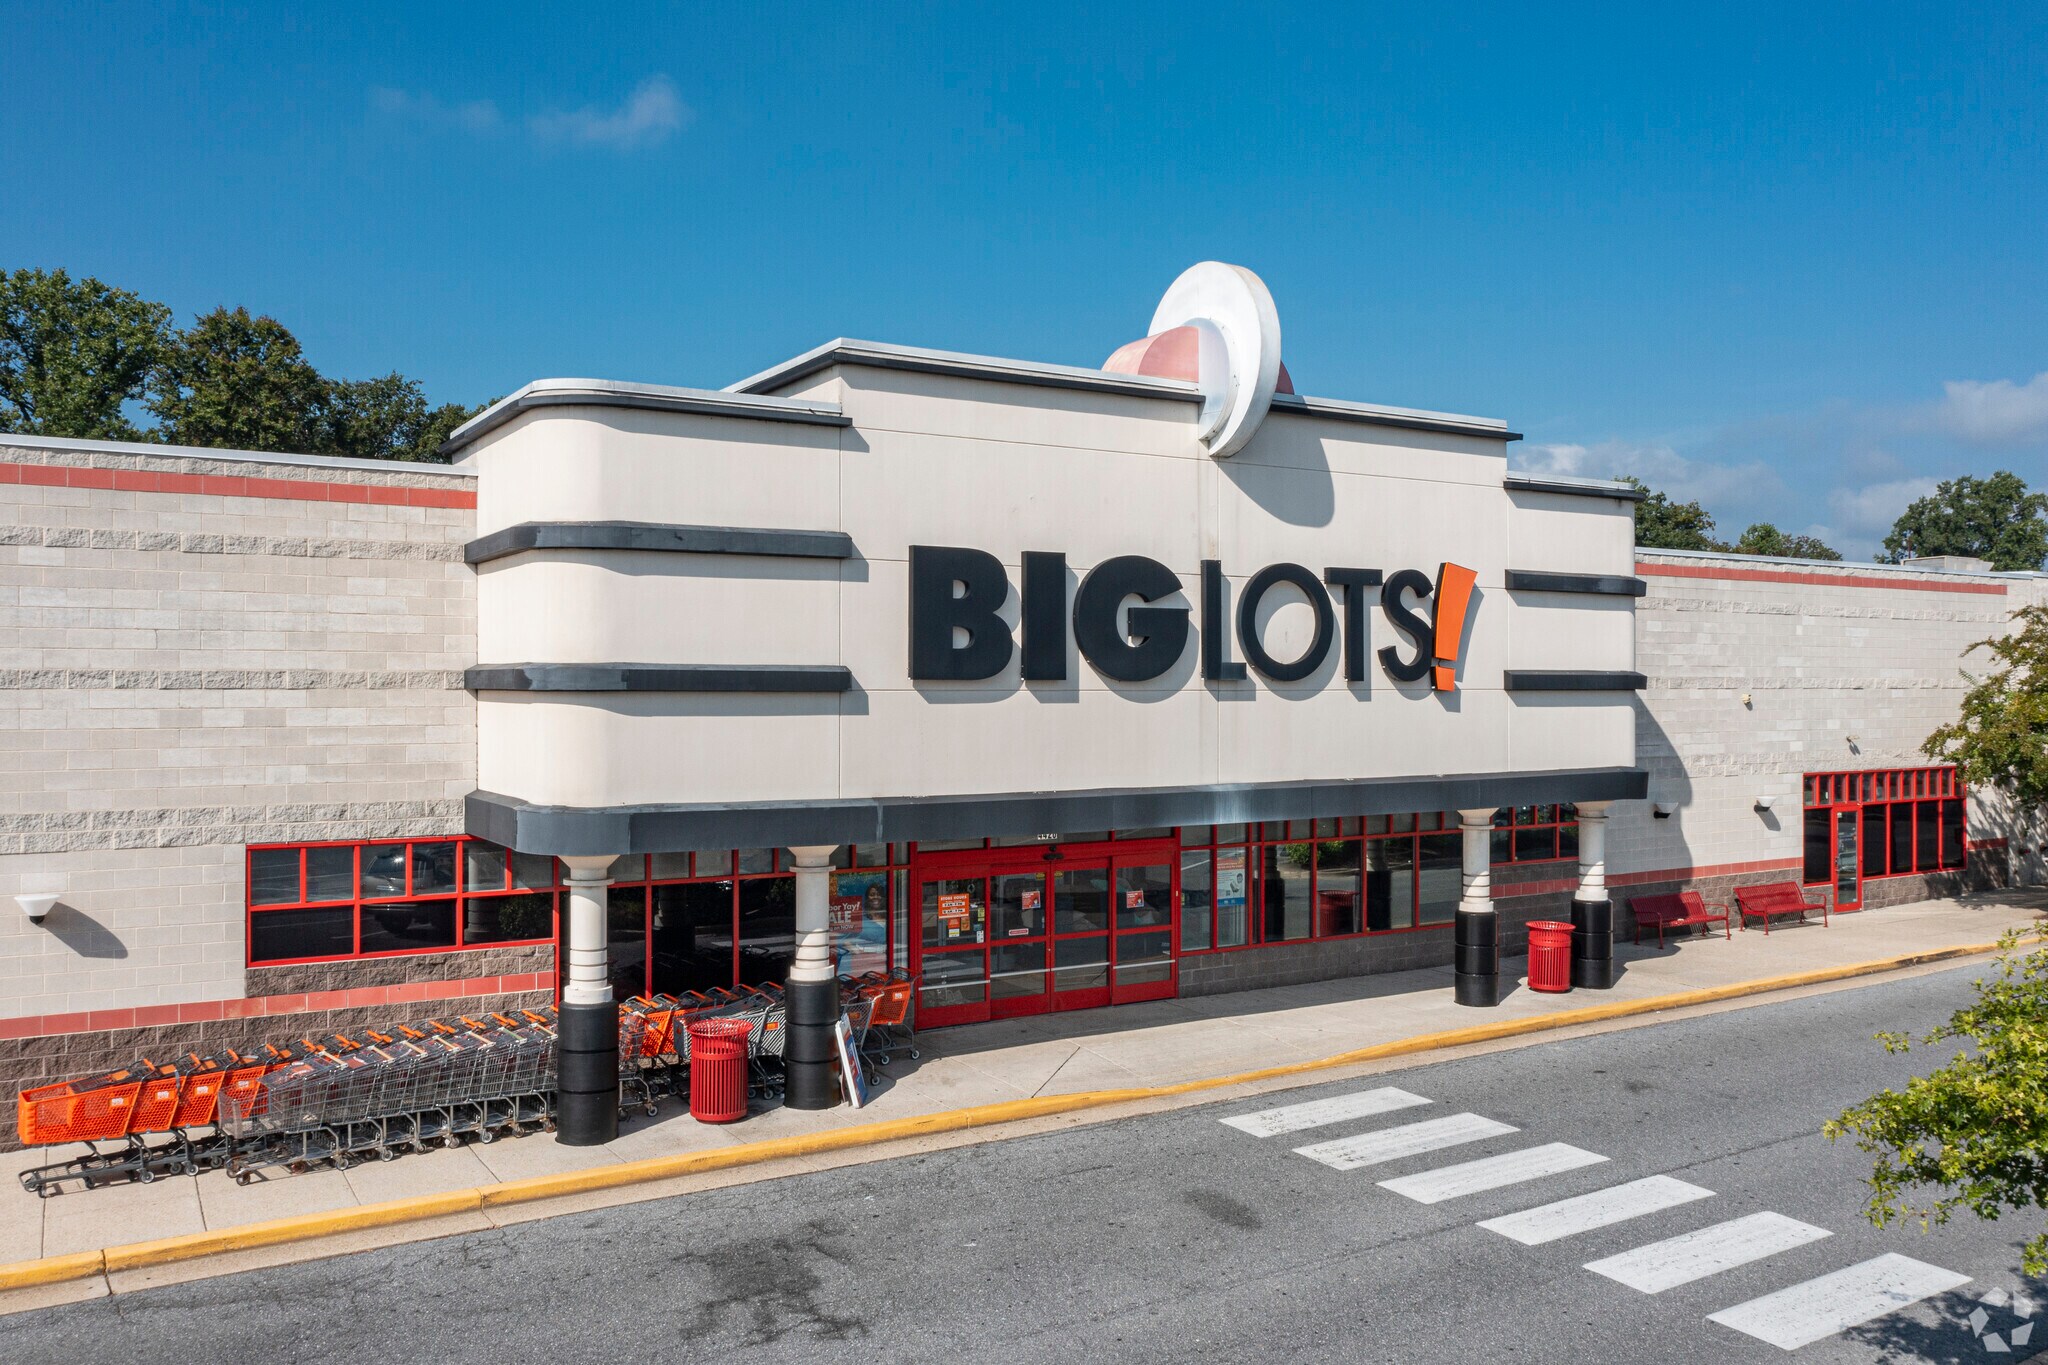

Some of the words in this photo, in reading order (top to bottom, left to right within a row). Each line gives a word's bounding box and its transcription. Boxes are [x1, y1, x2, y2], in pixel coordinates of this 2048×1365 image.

[908, 544, 1190, 682] BIG
[1200, 560, 1478, 692] LOTS!
[829, 910, 852, 924] ALE
